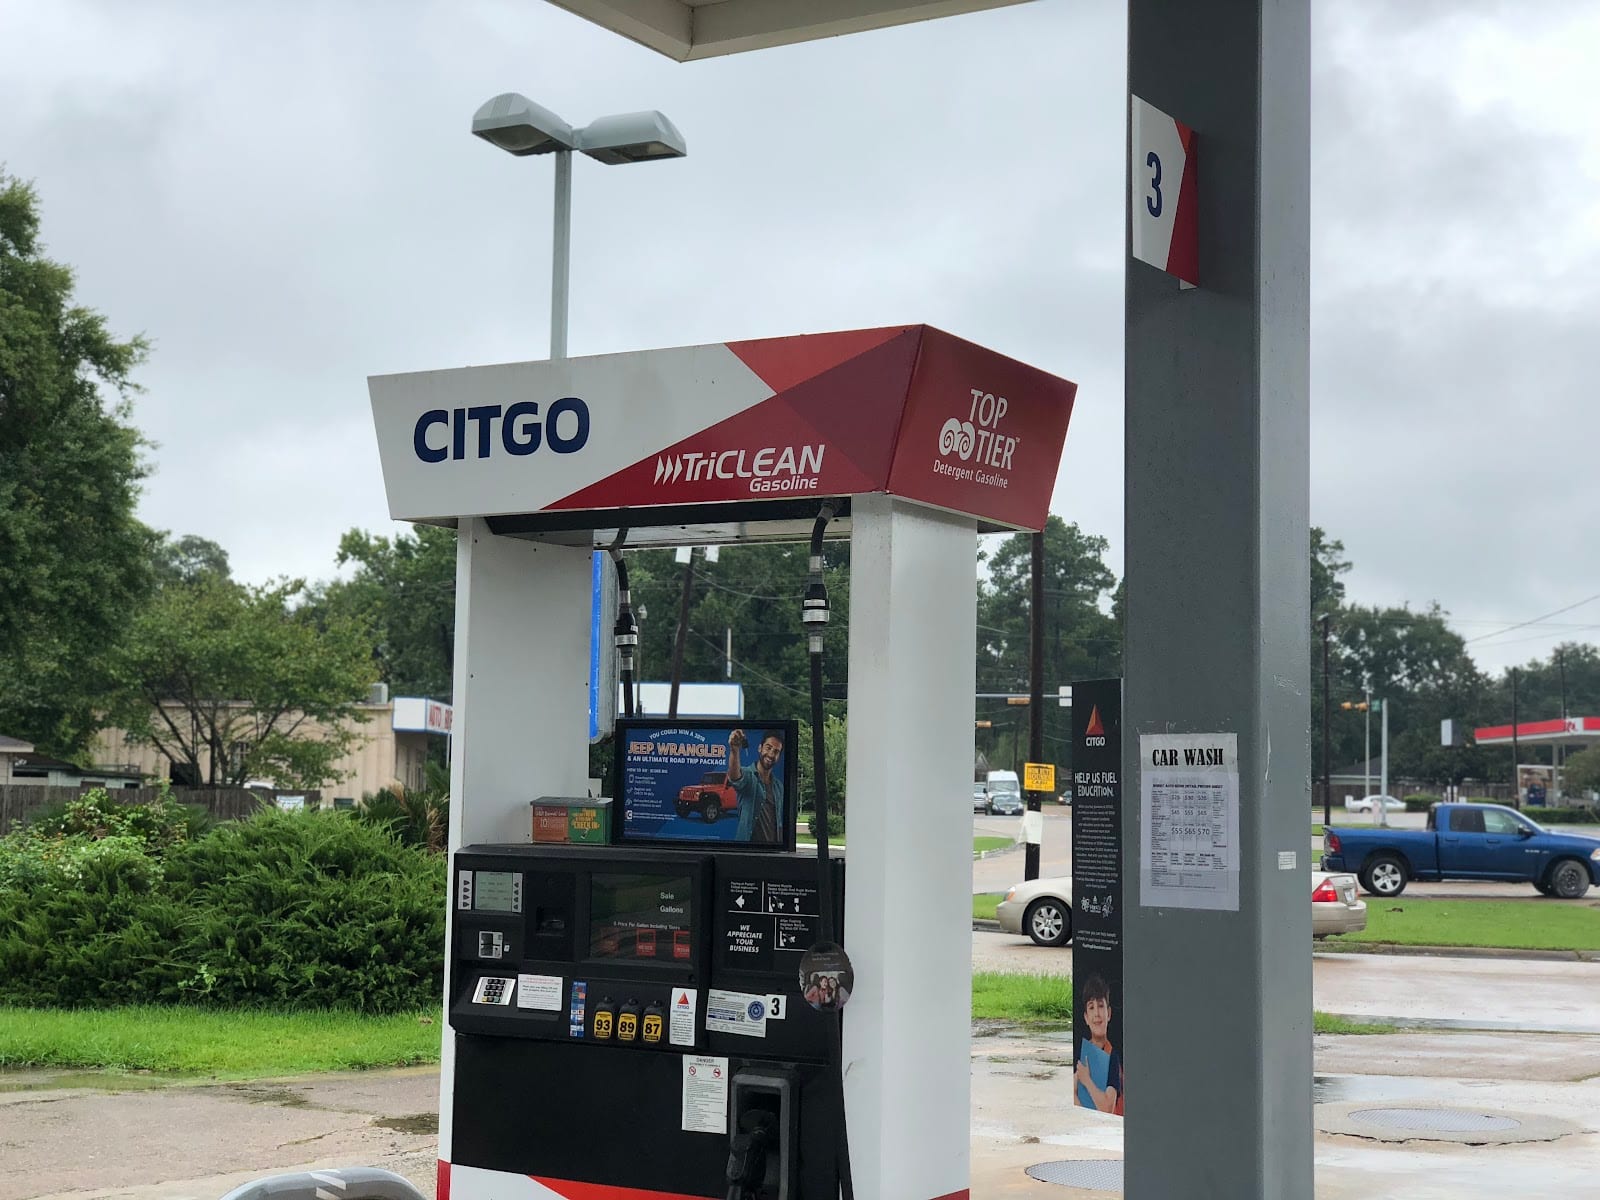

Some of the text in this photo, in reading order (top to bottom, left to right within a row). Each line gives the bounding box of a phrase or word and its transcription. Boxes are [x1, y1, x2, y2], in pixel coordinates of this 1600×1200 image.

[1146, 152, 1163, 217] 3
[969, 388, 1008, 429] TOP
[413, 397, 590, 463] CITGO
[683, 444, 825, 481] TriCLEAN
[933, 459, 1008, 488] Detergent Gasoline
[750, 475, 818, 492] Gasoline
[649, 731, 660, 740] YOU
[1085, 737, 1106, 747] CITGO
[656, 742, 726, 758] WRANGLER
[700, 758, 726, 766] PACKAGE
[1152, 748, 1224, 766] CAR WASH
[1074, 772, 1118, 784] HELP US FUEL
[1171, 827, 1183, 835] $55
[660, 892, 674, 900] Sale
[660, 905, 684, 914] Gallons
[727, 931, 763, 939] APPRECIATE
[735, 938, 754, 946] YOUR
[729, 945, 760, 953] BUSINESS
[771, 997, 780, 1016] 3
[596, 1019, 611, 1031] 93
[619, 1021, 635, 1033] 89
[644, 1023, 660, 1034] 87
